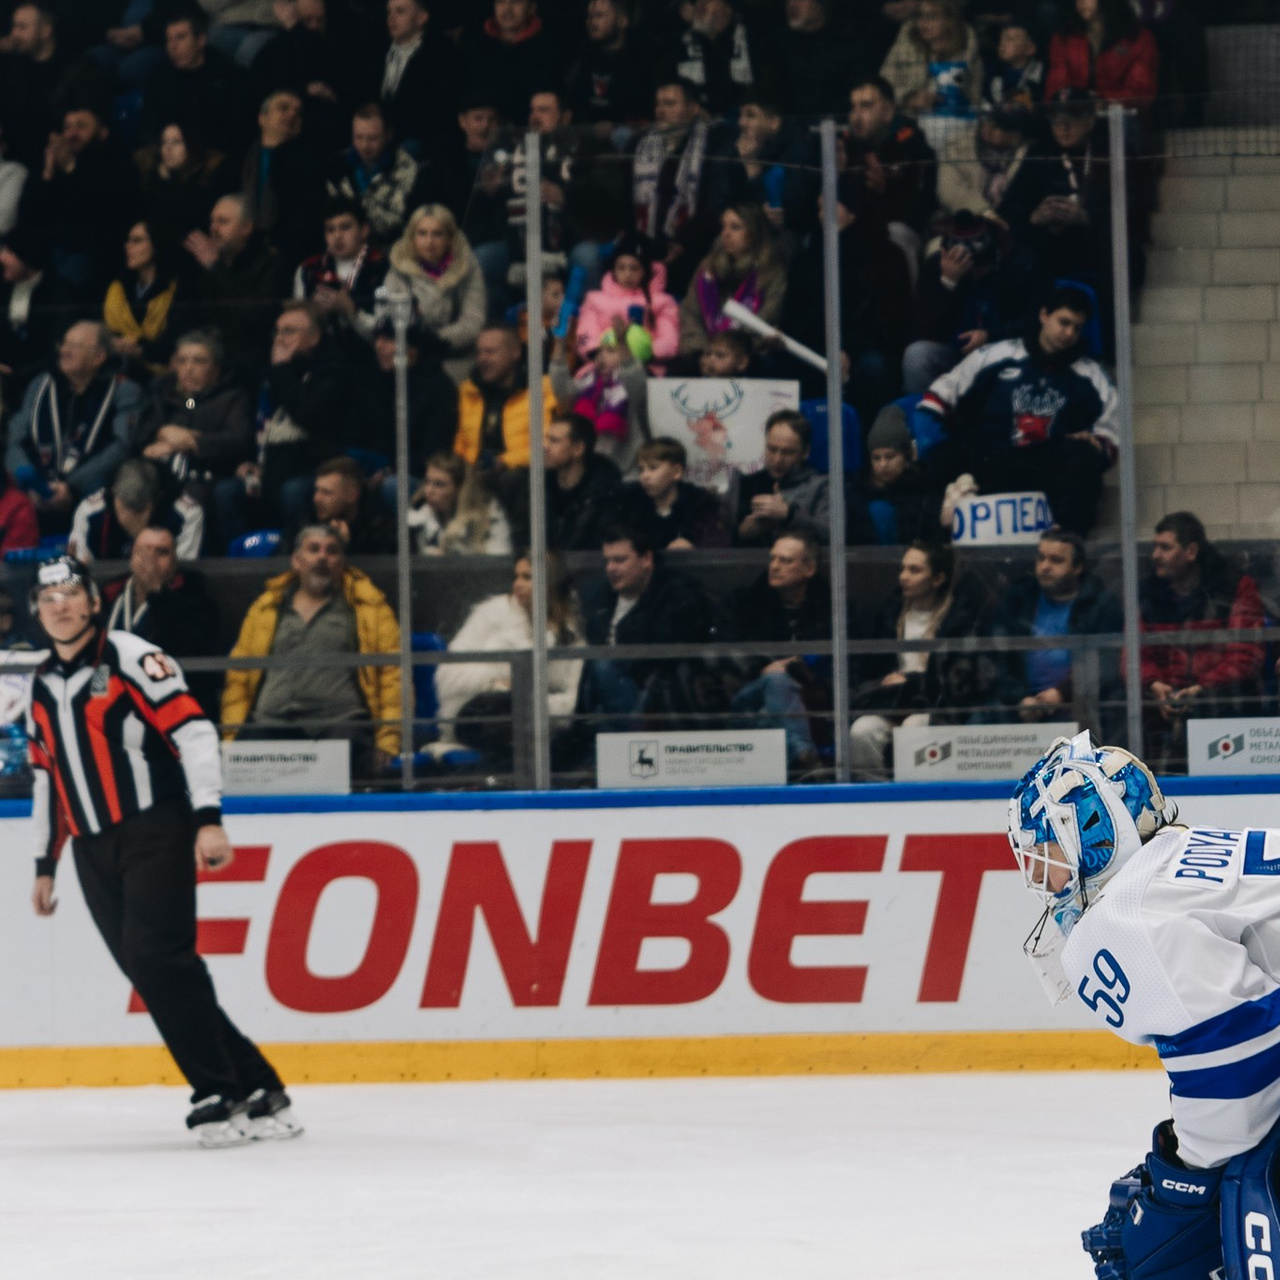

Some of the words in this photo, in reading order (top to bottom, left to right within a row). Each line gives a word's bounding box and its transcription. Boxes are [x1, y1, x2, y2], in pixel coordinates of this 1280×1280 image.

[665, 743, 754, 754] ПРАВИТЕЛЬСТВО
[1078, 947, 1131, 1029] 59
[1162, 1178, 1206, 1195] CCM
